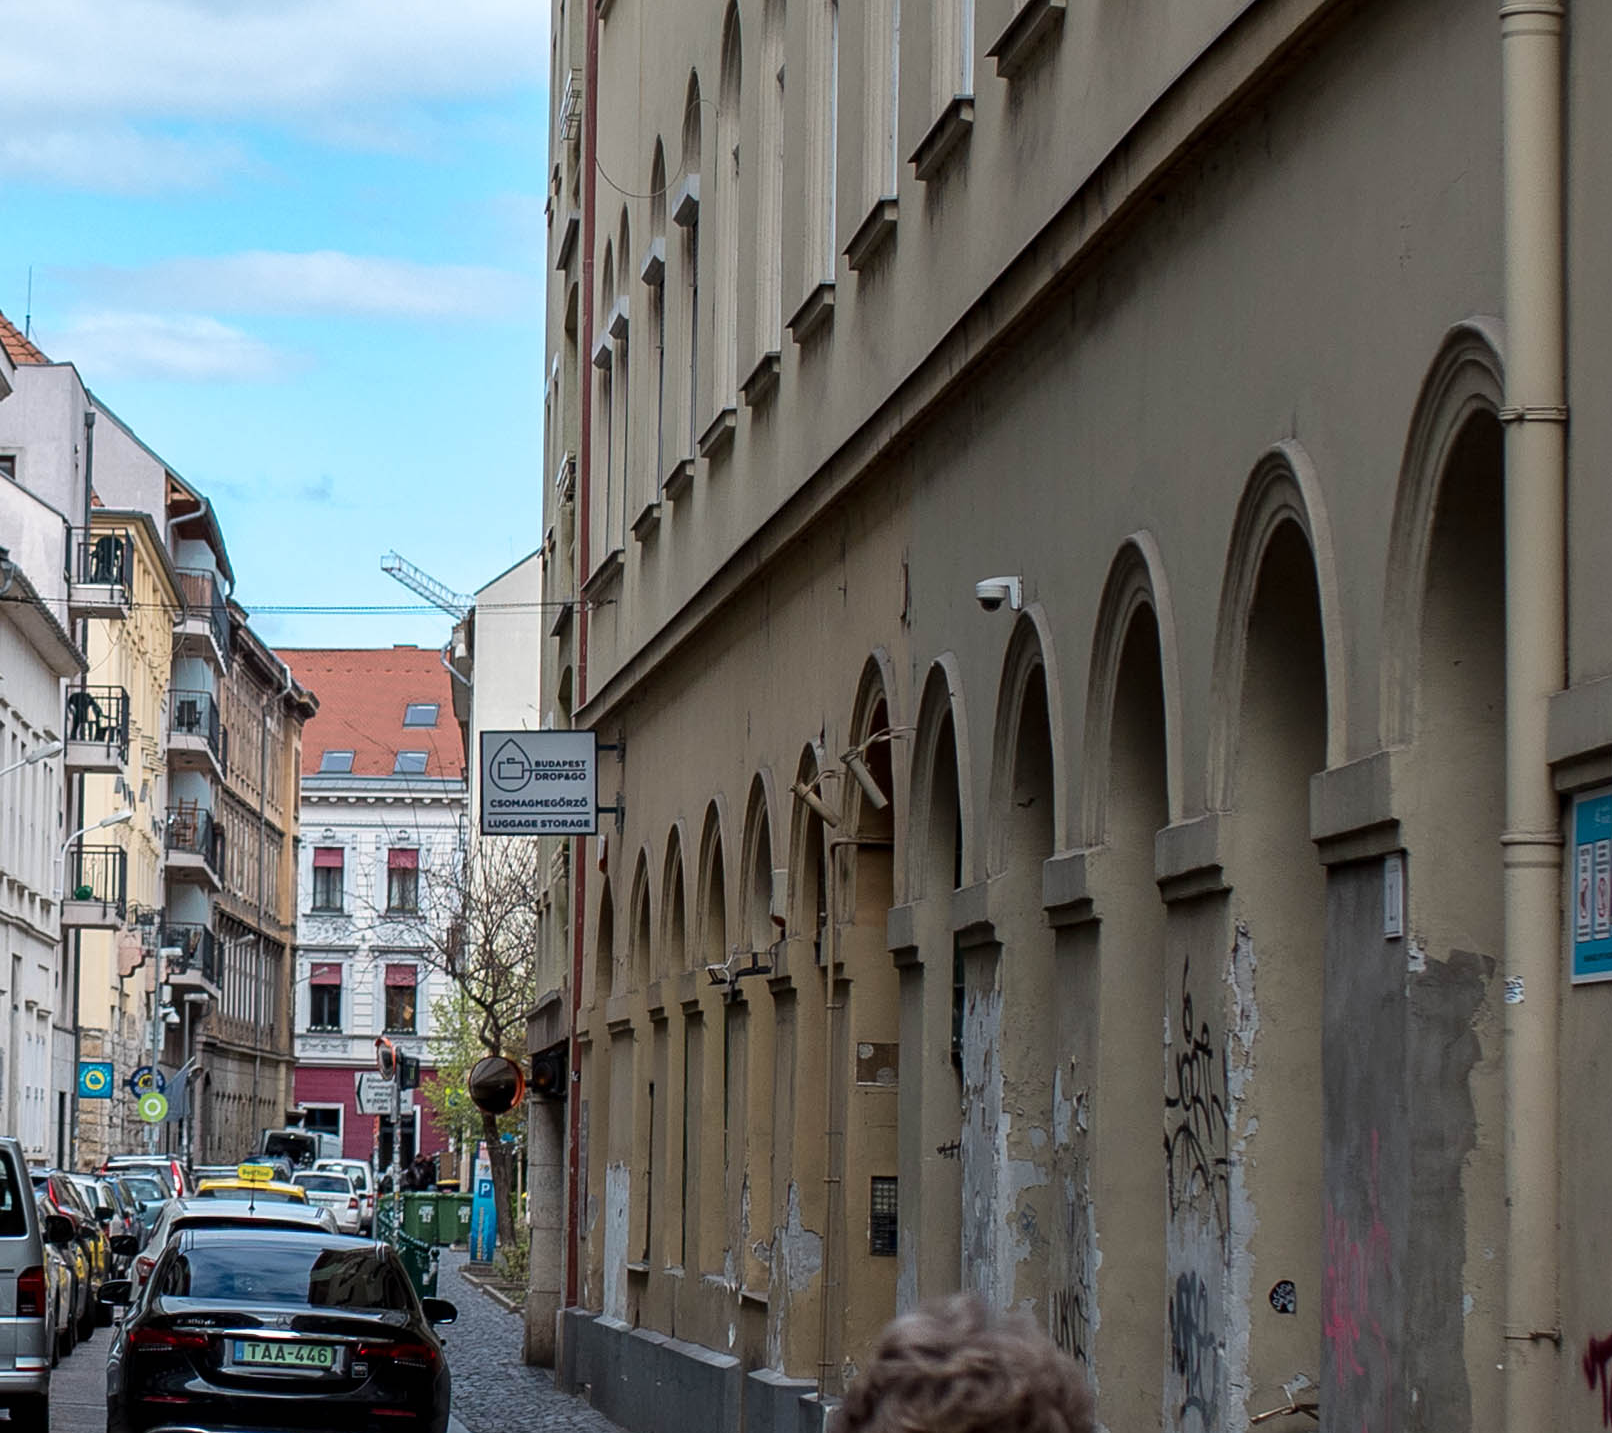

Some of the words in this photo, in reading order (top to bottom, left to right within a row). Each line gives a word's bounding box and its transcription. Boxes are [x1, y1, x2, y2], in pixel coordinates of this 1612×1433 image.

[534, 760, 587, 768] BUDAPEST
[534, 773, 587, 781] DROP&GO
[490, 797, 588, 807] CSOMAGMEGŐRZŐ
[488, 819, 538, 828] LUGGAGE
[540, 819, 590, 828] STORAGE
[247, 1343, 328, 1364] TAA-446
